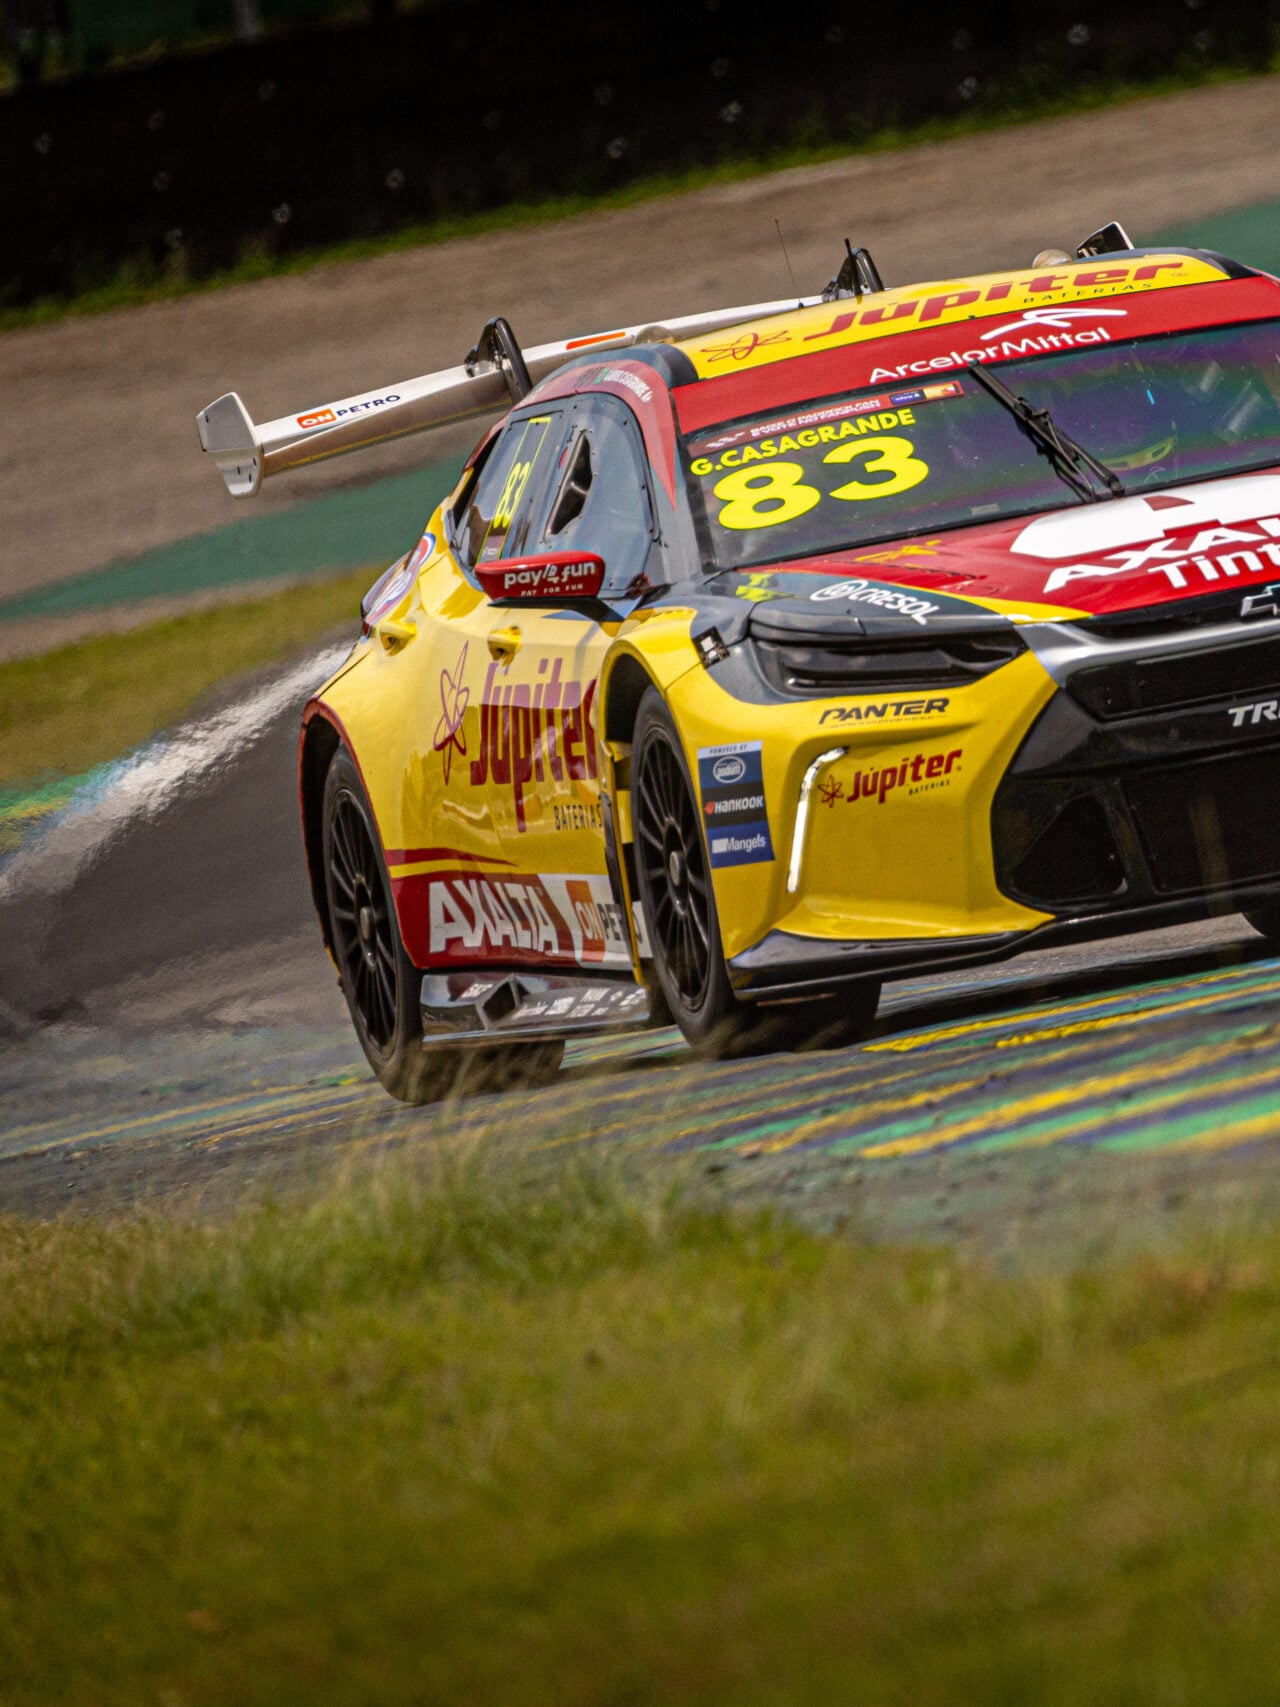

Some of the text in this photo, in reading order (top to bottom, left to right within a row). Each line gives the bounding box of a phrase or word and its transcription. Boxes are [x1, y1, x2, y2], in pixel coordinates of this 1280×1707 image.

[1022, 282, 1153, 305] BATERIAS
[868, 327, 1111, 384] ArcelorMittal
[301, 394, 401, 426] ON PETRO
[690, 408, 916, 476] G.CASAGRANDE
[493, 461, 531, 529] 83
[713, 435, 930, 531] 83
[848, 588, 940, 626] CRESOL
[818, 697, 950, 725] PANTER
[908, 779, 951, 796] BATERIAS
[553, 802, 605, 831] BATERIAS
[428, 878, 559, 954] AXALTA
